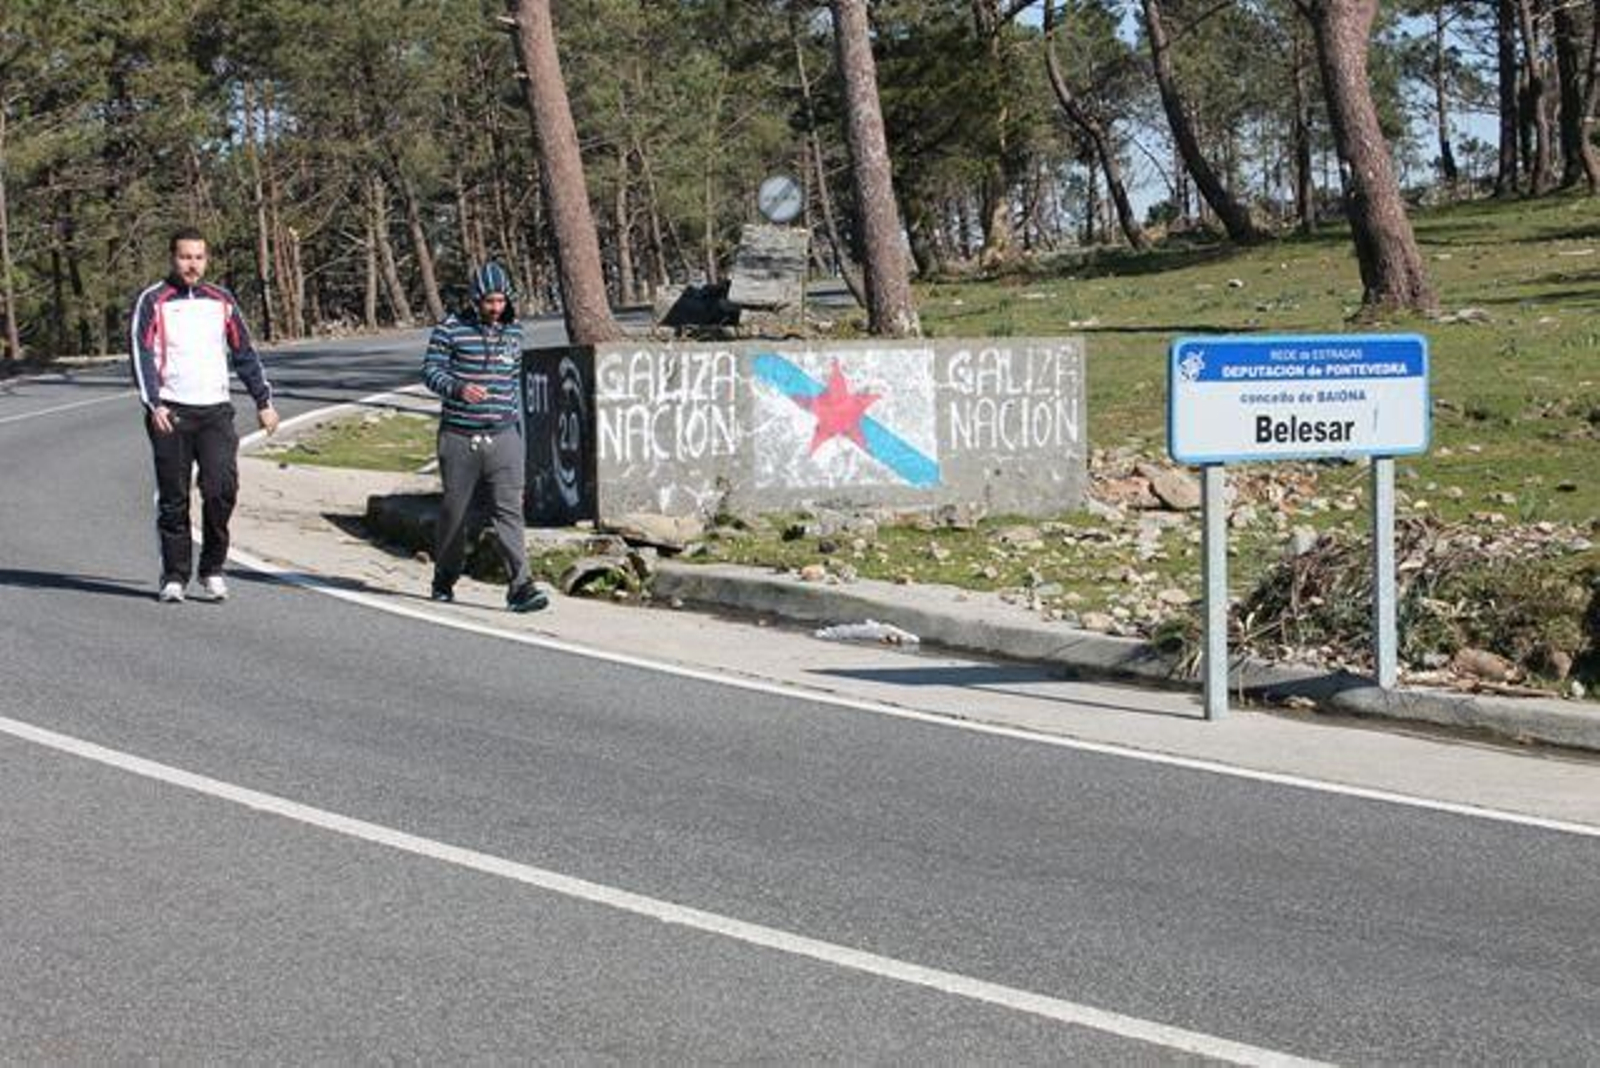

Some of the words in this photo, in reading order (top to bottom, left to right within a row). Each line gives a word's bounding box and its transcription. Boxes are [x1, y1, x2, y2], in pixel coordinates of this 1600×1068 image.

[1270, 349, 1298, 361] REDE
[1312, 348, 1363, 360] ESTRADAS
[598, 350, 736, 403] GALIZA
[949, 345, 1078, 396] GALIZA
[1307, 363, 1323, 377] de
[1326, 362, 1408, 377] PONTEVEDRA
[1239, 391, 1295, 404] concello
[1299, 391, 1313, 403] de
[1255, 413, 1355, 444] Belesar
